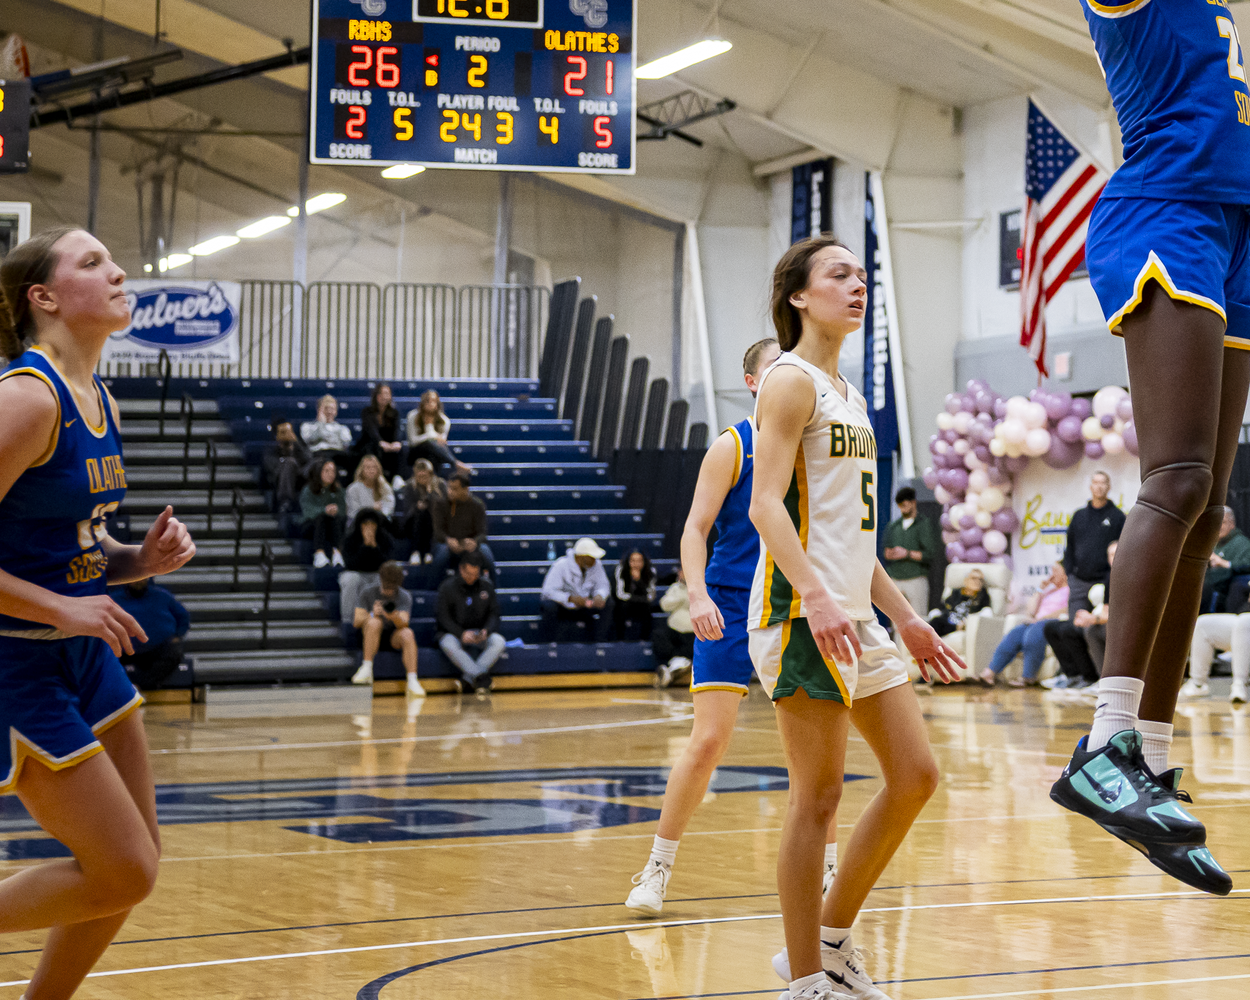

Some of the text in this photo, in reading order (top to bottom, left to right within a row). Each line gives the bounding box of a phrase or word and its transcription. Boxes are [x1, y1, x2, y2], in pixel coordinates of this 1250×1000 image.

[349, 20, 392, 42] RBHS
[544, 30, 619, 53] OLATHES
[455, 36, 500, 52] PERIOD
[1215, 16, 1248, 84] 2
[348, 45, 400, 87] 26
[468, 55, 487, 87] 2
[564, 56, 613, 96] 21
[330, 89, 371, 105] FOULS
[387, 91, 421, 107] T.O.L.
[437, 93, 520, 111] PLAYER FOUL
[533, 98, 565, 113] T.O.L.
[579, 100, 618, 115] FOULS
[346, 106, 367, 139] 2
[393, 108, 414, 141] 5
[440, 110, 481, 143] 24
[539, 116, 559, 144] 4
[594, 117, 613, 148] 5
[329, 144, 372, 159] SCORE
[454, 148, 498, 164] MATCH
[579, 153, 619, 168] SCORE
[829, 422, 877, 461] BRUIN
[860, 470, 875, 532] 5
